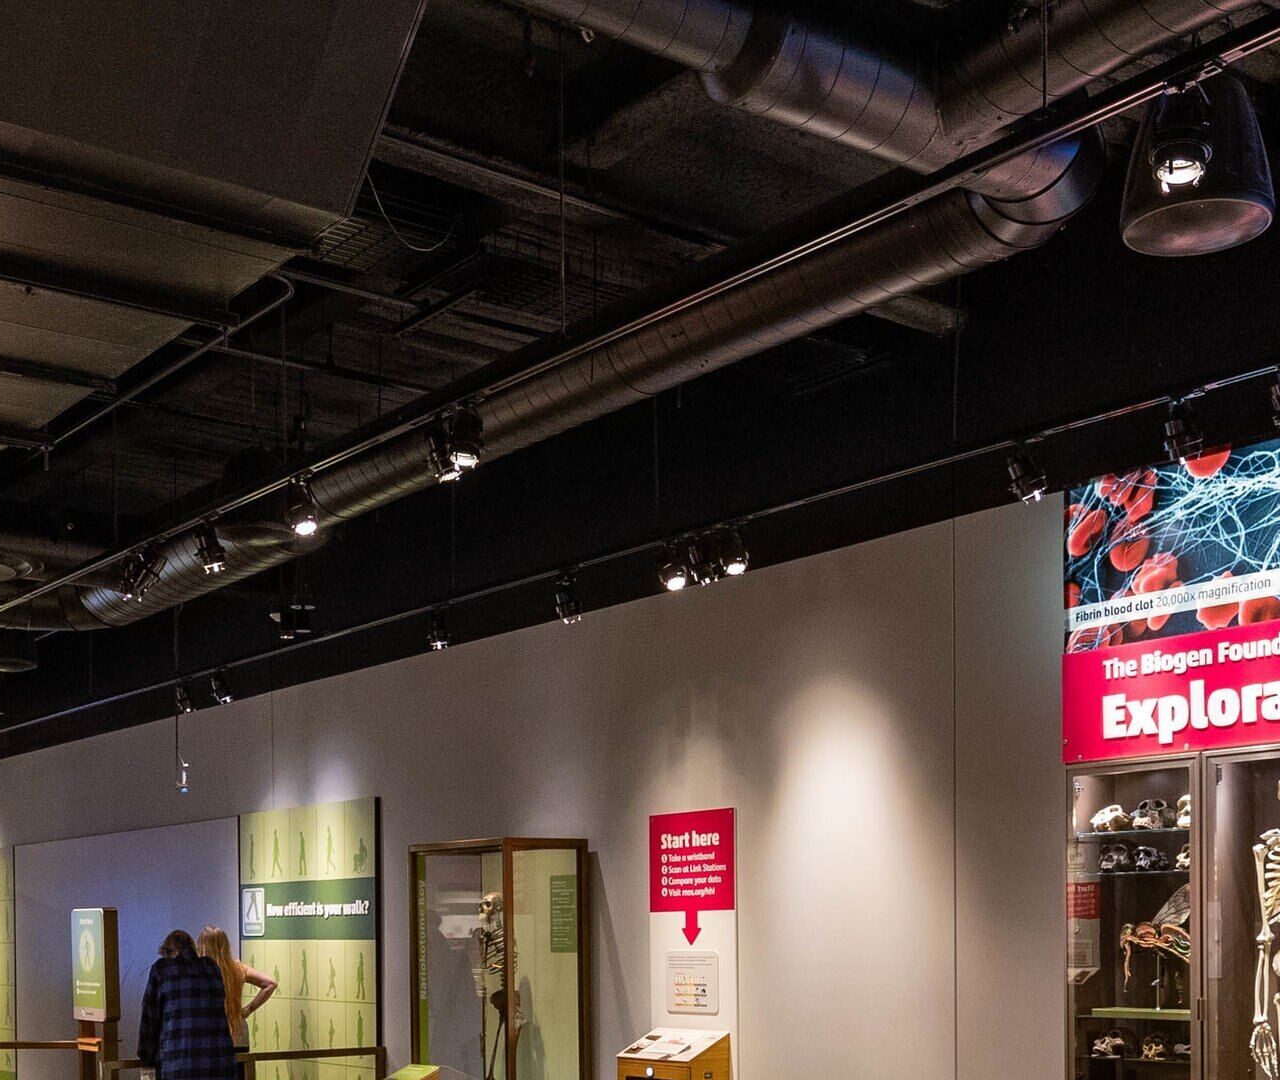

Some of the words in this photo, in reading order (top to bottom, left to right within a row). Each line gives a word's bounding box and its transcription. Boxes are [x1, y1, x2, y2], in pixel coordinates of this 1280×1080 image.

[1075, 609, 1102, 623] Fibrin
[1104, 603, 1132, 617] blood
[1135, 599, 1154, 612] clot
[1156, 592, 1196, 607] 20,000x
[1198, 578, 1271, 600] magnification
[1102, 657, 1138, 680] The
[1141, 647, 1213, 675] Biogen
[660, 832, 690, 850] Start
[691, 830, 720, 847] here
[668, 854, 681, 862] Take
[687, 851, 715, 861] wristband
[668, 865, 682, 874] Scan
[682, 865, 690, 873] at
[690, 864, 702, 872] Link
[703, 863, 727, 872] Stations
[668, 877, 693, 887] Compare
[694, 877, 707, 886] your
[707, 875, 722, 883] data
[668, 888, 681, 896] Visit
[266, 903, 283, 917] How
[283, 901, 316, 916] efficient
[316, 901, 324, 916] is
[324, 903, 342, 920] your
[342, 899, 369, 916] walk?
